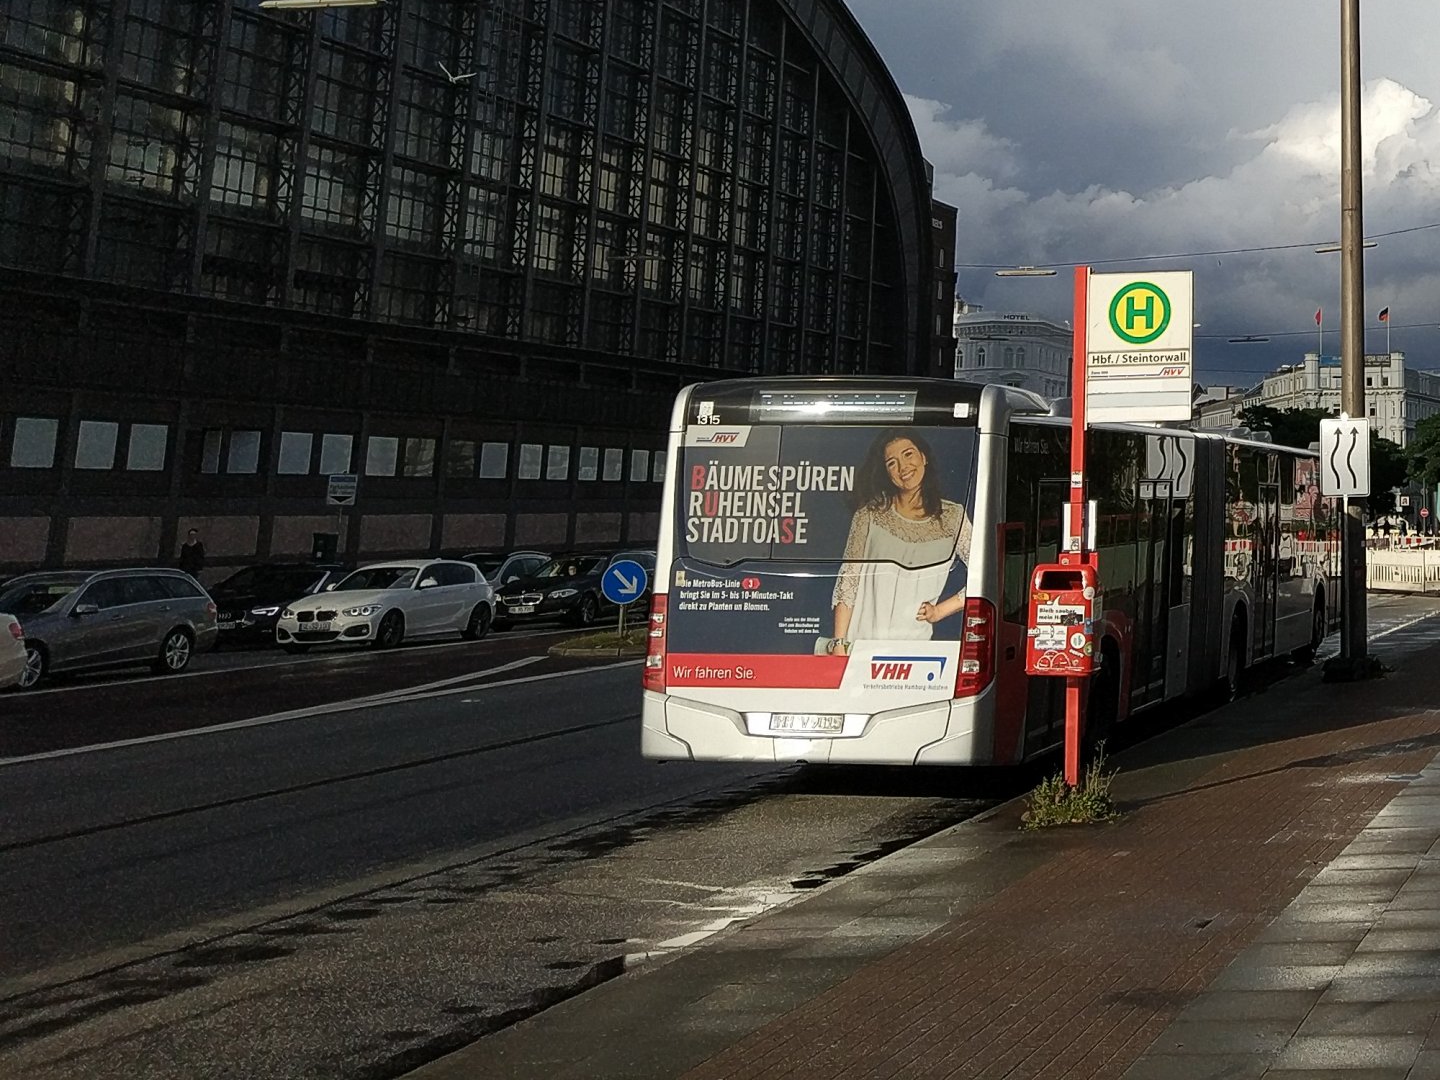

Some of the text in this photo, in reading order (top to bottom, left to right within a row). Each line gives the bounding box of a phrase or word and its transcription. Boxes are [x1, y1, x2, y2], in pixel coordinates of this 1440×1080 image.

[1125, 295, 1155, 330] H
[1092, 354, 1114, 364] Hbf.
[1122, 351, 1187, 364] Steintorwall
[1162, 367, 1184, 376] HVV
[696, 414, 721, 425] 1315
[714, 434, 738, 443] HVV
[691, 460, 855, 492] BÄUME SPÜREN
[688, 491, 806, 518] RUHEINSEL
[685, 517, 809, 544] STADTOASE
[692, 579, 741, 589] MetroBus-Linie
[748, 580, 753, 588] 3
[679, 590, 794, 601] bringt Sie im 5- bis 10-Minuten-Takt
[678, 602, 770, 612] direkt zu Planten un Blomen.
[672, 665, 757, 680] Wir fahren Sie.
[870, 663, 913, 680] VHH
